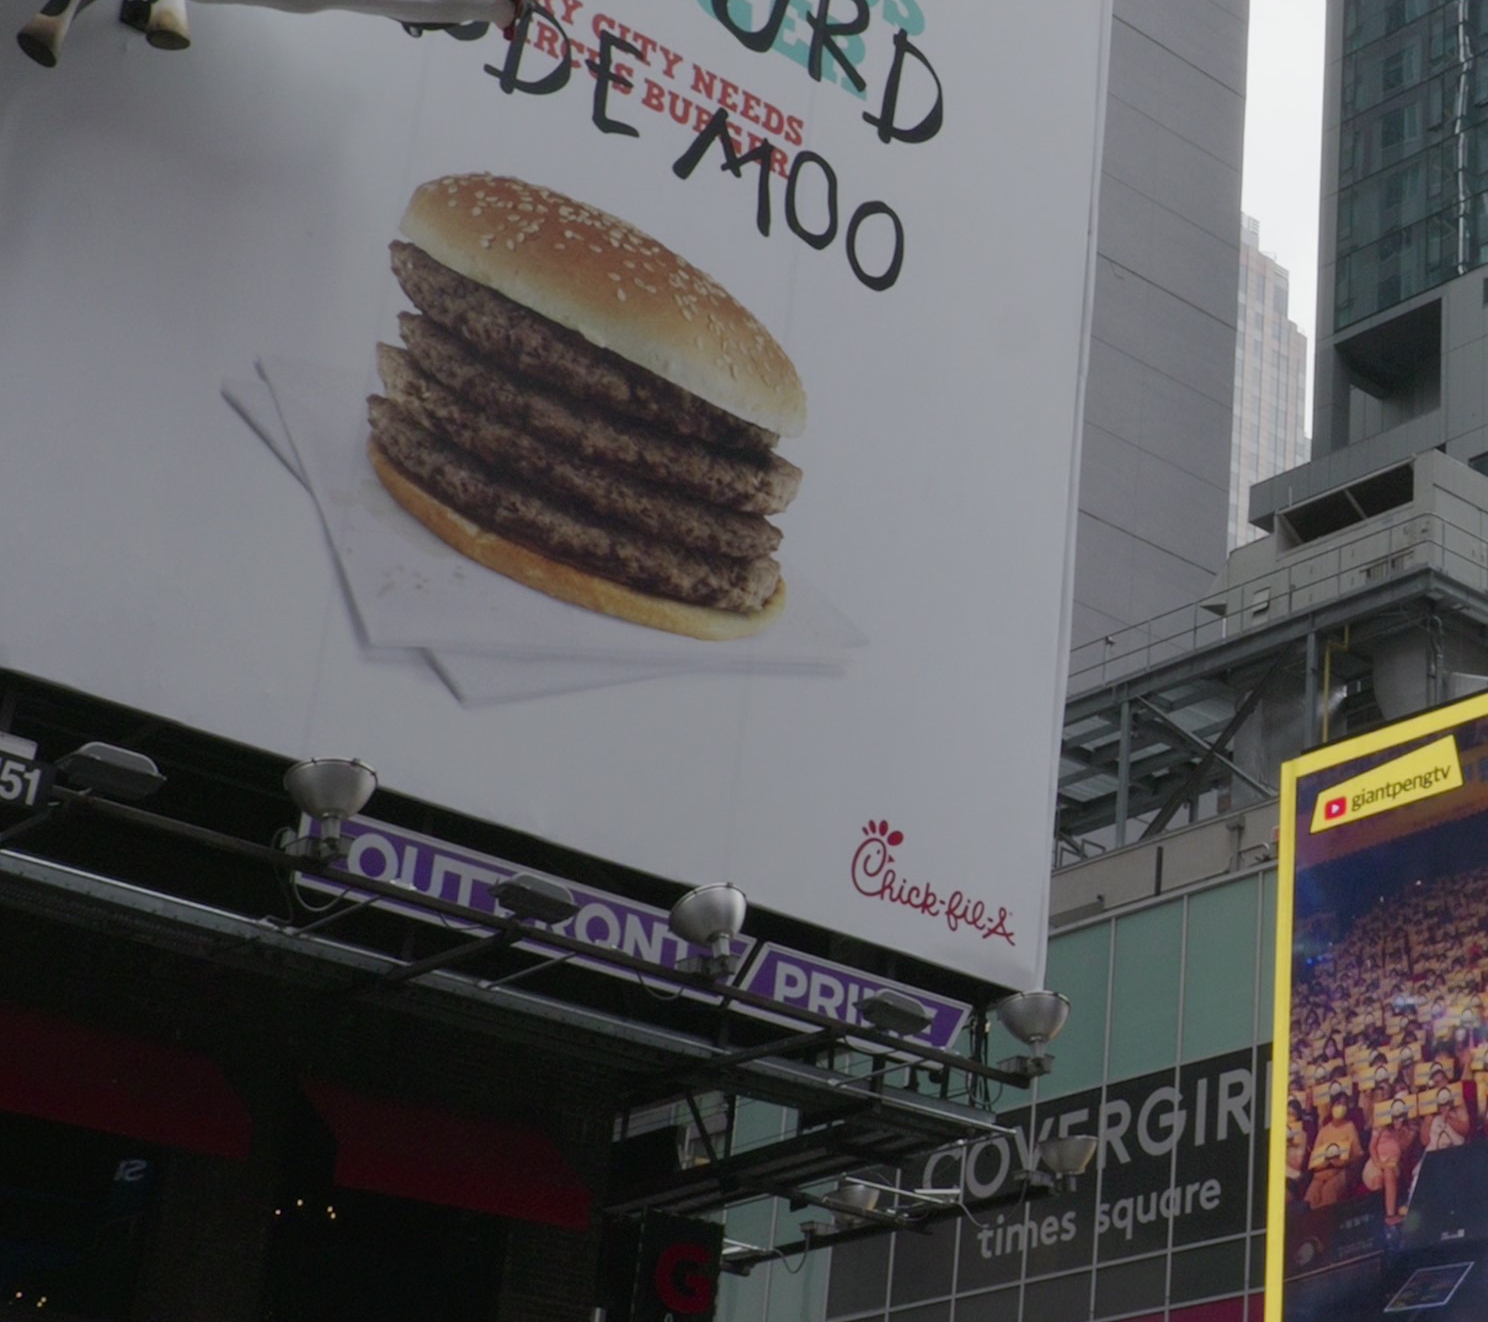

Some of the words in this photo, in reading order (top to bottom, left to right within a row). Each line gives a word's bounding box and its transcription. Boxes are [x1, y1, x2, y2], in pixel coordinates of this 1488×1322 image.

[691, 62, 805, 147] NEEDS
[671, 108, 905, 292] MOO
[1350, 764, 1452, 813] giantpengtv
[348, 832, 698, 970] OUTONT
[774, 967, 937, 1042] PRI
[851, 819, 1016, 947] Chick-fil-A
[921, 1060, 1273, 1201] COVERGIR
[977, 1207, 1077, 1260] times
[1096, 1176, 1222, 1240] square
